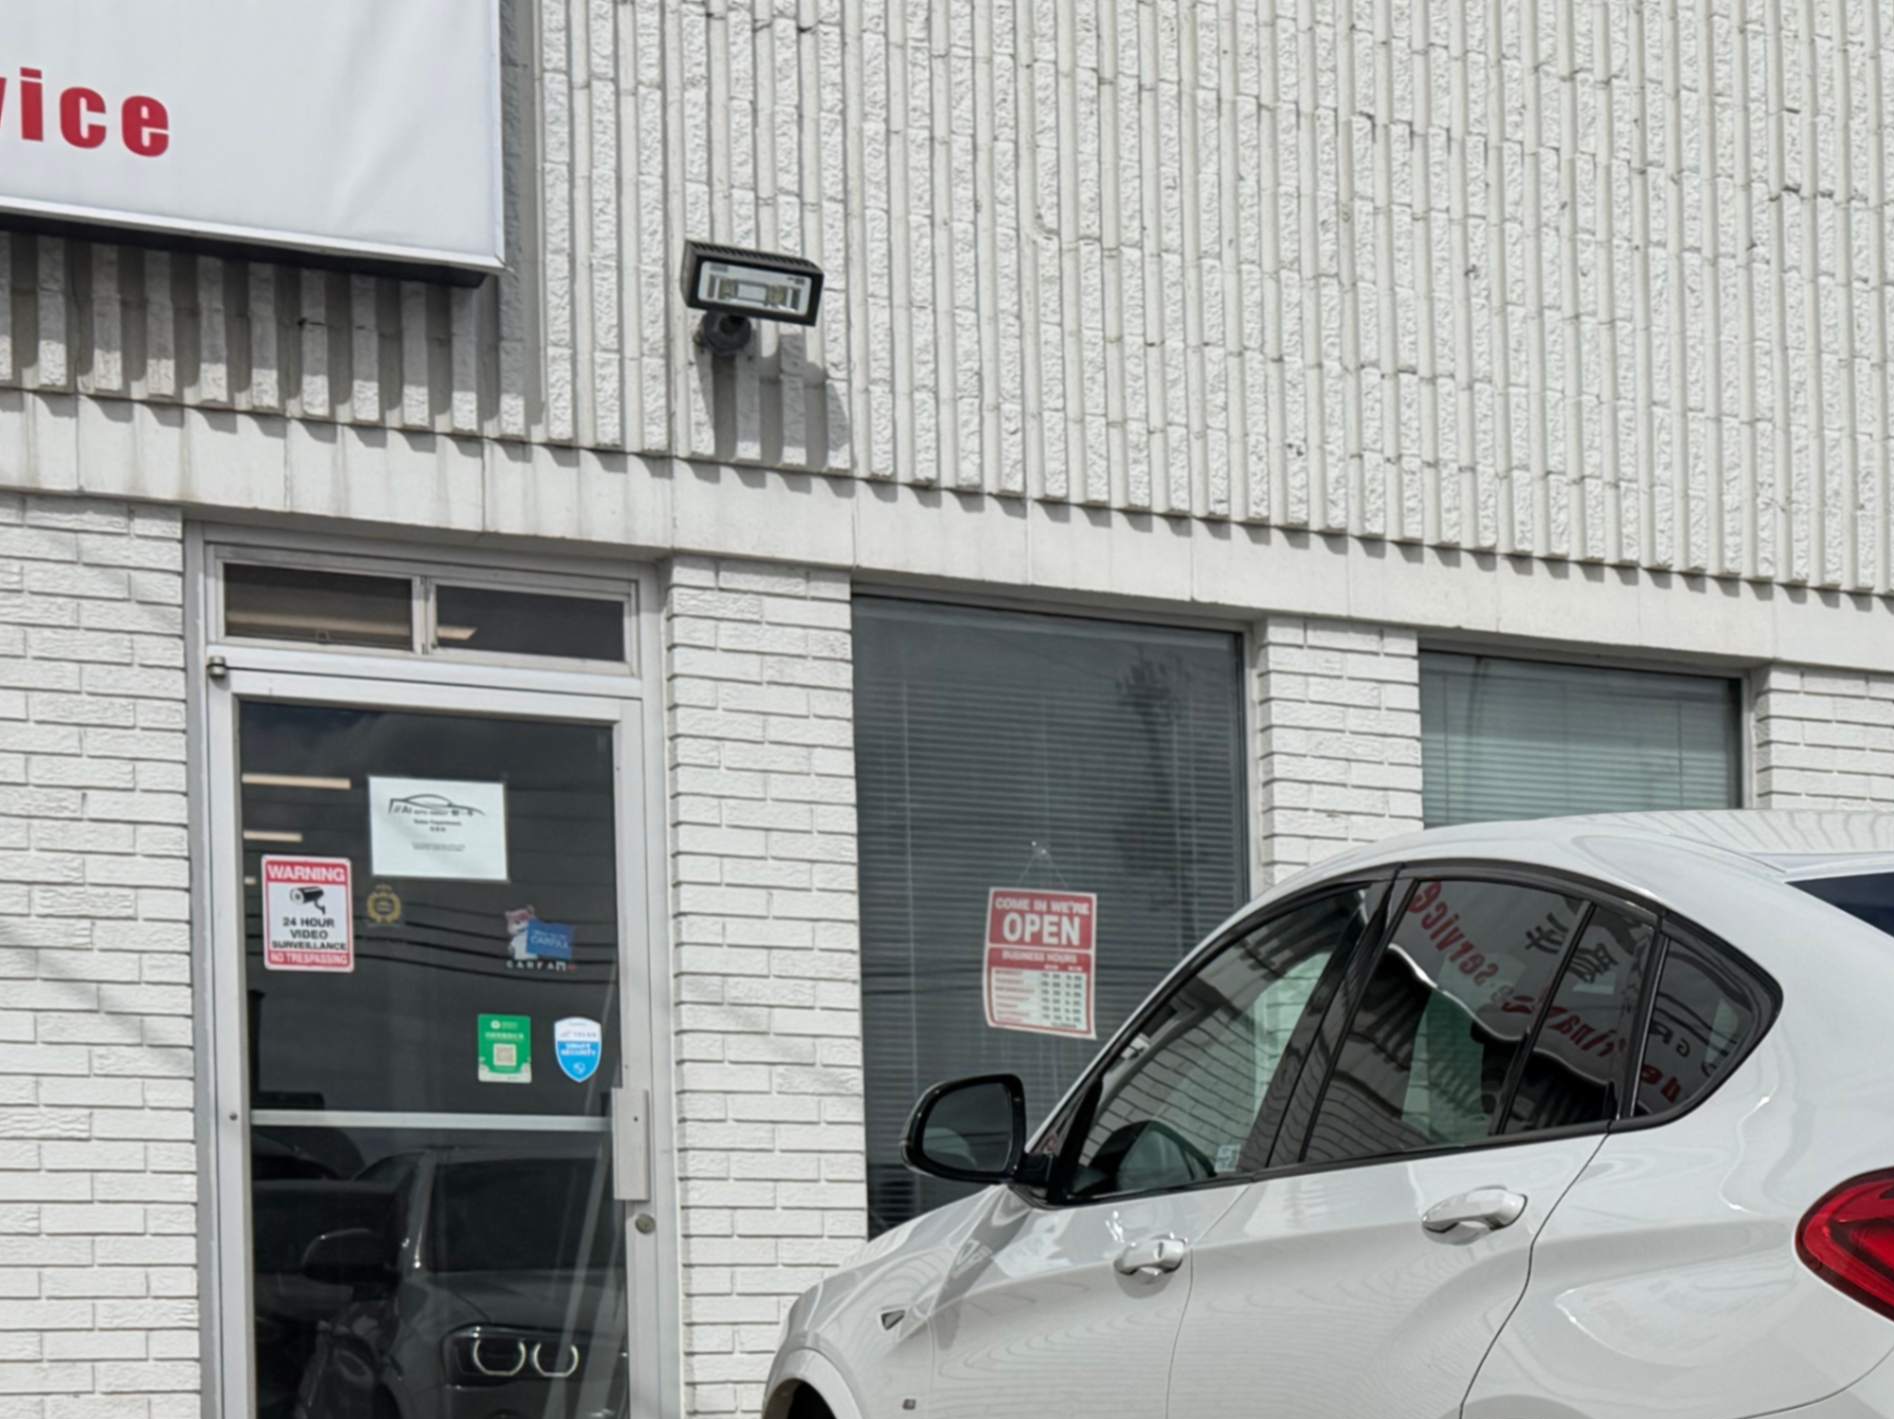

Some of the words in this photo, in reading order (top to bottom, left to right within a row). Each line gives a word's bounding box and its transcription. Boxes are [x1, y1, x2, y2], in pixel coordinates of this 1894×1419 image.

[0, 66, 170, 158] ice
[267, 864, 346, 882] WARNING
[995, 898, 1030, 911] COME
[1033, 900, 1047, 912] IN
[282, 917, 297, 927] 24
[300, 917, 335, 928] HOUR
[1003, 912, 1080, 946] OPEN
[290, 929, 328, 939] VIDEO
[271, 941, 346, 951] SURVEILLANCE
[270, 952, 285, 962] NO
[286, 952, 348, 964] TRESPASSING
